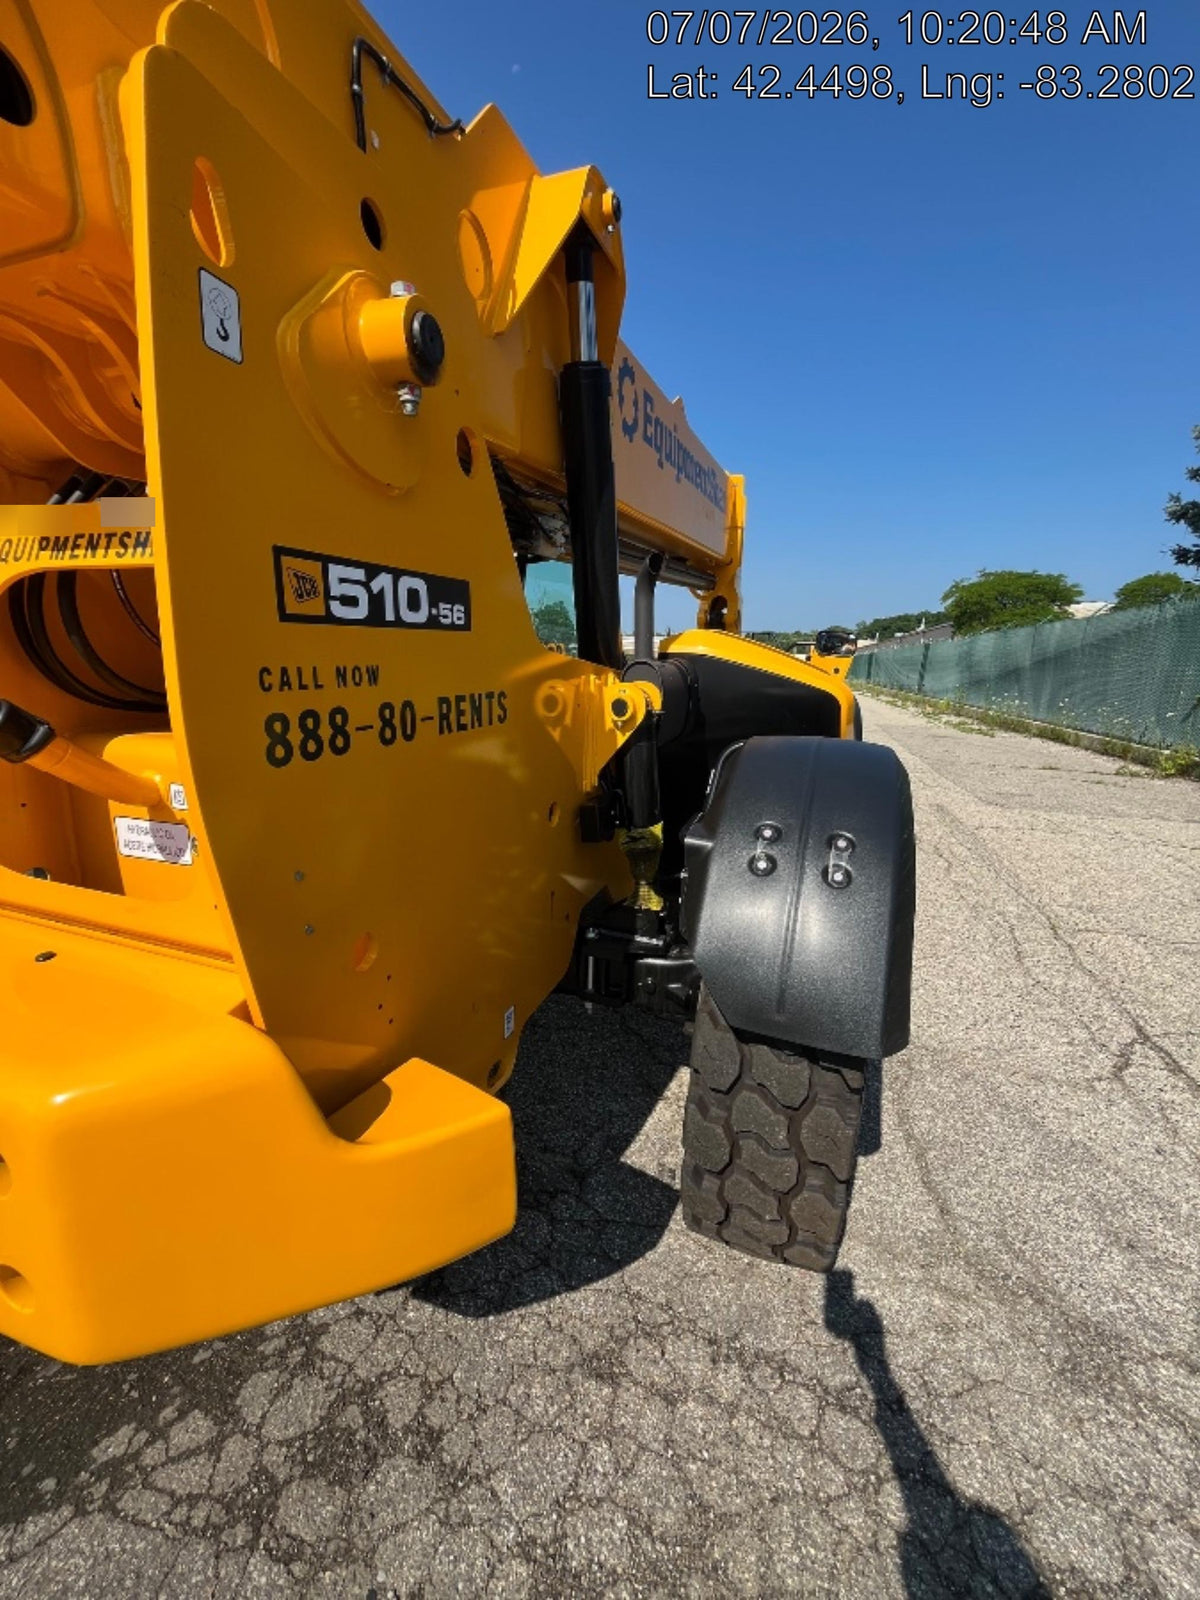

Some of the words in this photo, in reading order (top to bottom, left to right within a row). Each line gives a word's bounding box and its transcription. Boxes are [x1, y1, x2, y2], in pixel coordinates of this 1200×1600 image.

[0, 531, 153, 563] QUIPMENTSH
[258, 666, 324, 692] CALL
[335, 664, 380, 688] NOW
[264, 690, 508, 768] 888-80-RENTS
